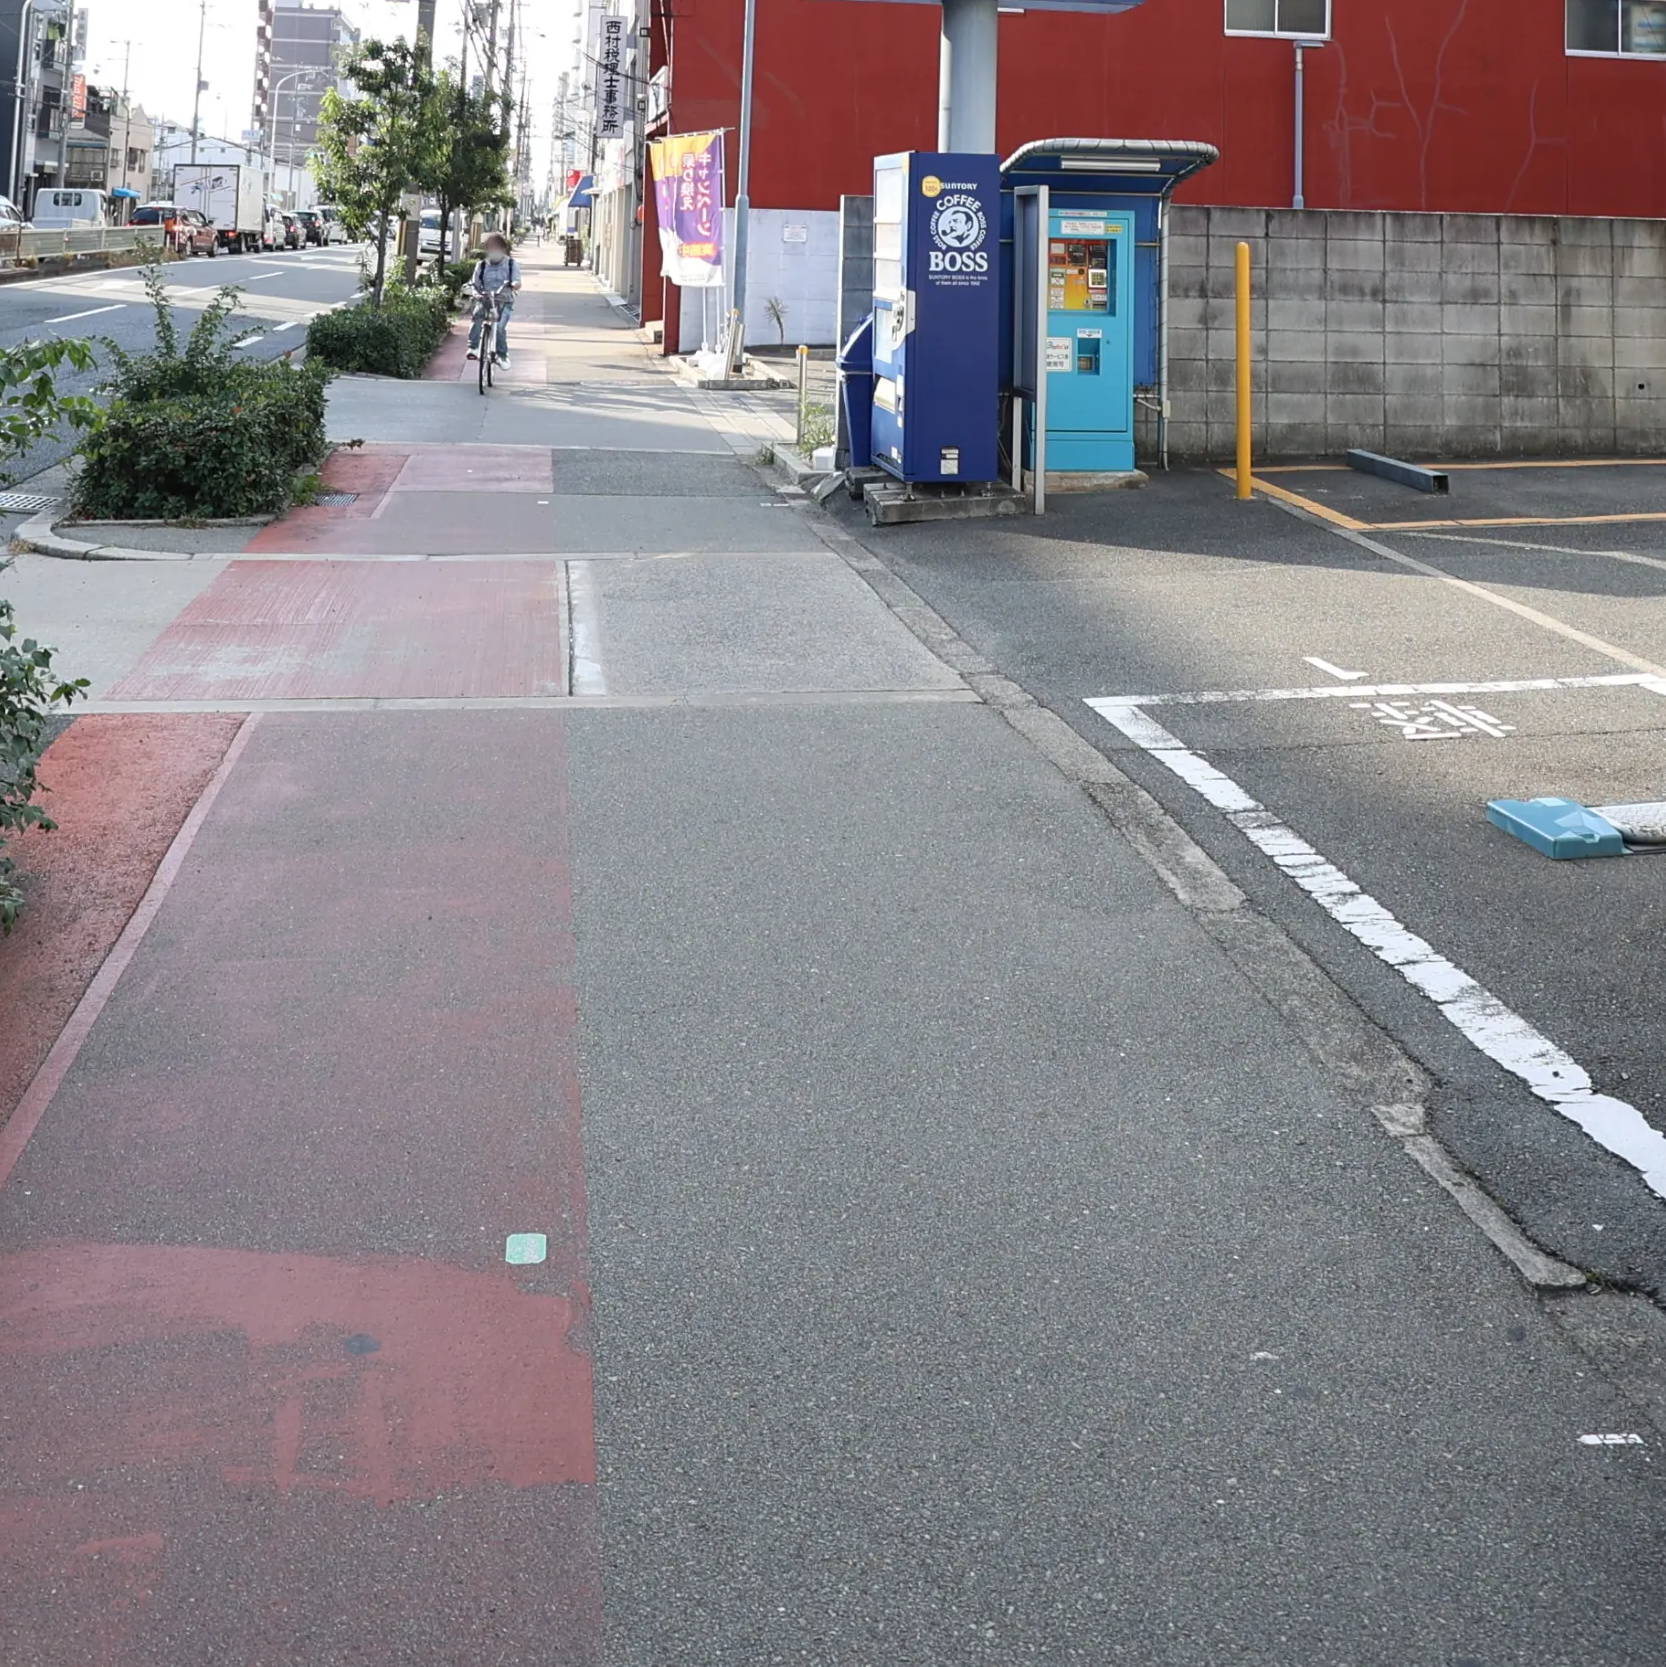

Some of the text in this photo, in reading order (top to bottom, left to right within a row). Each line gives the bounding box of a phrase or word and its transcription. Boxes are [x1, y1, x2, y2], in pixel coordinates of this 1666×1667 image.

[600, 20, 623, 134] 西村税理士事務所
[936, 194, 981, 212] COFFEE
[929, 251, 988, 272] BOSS
